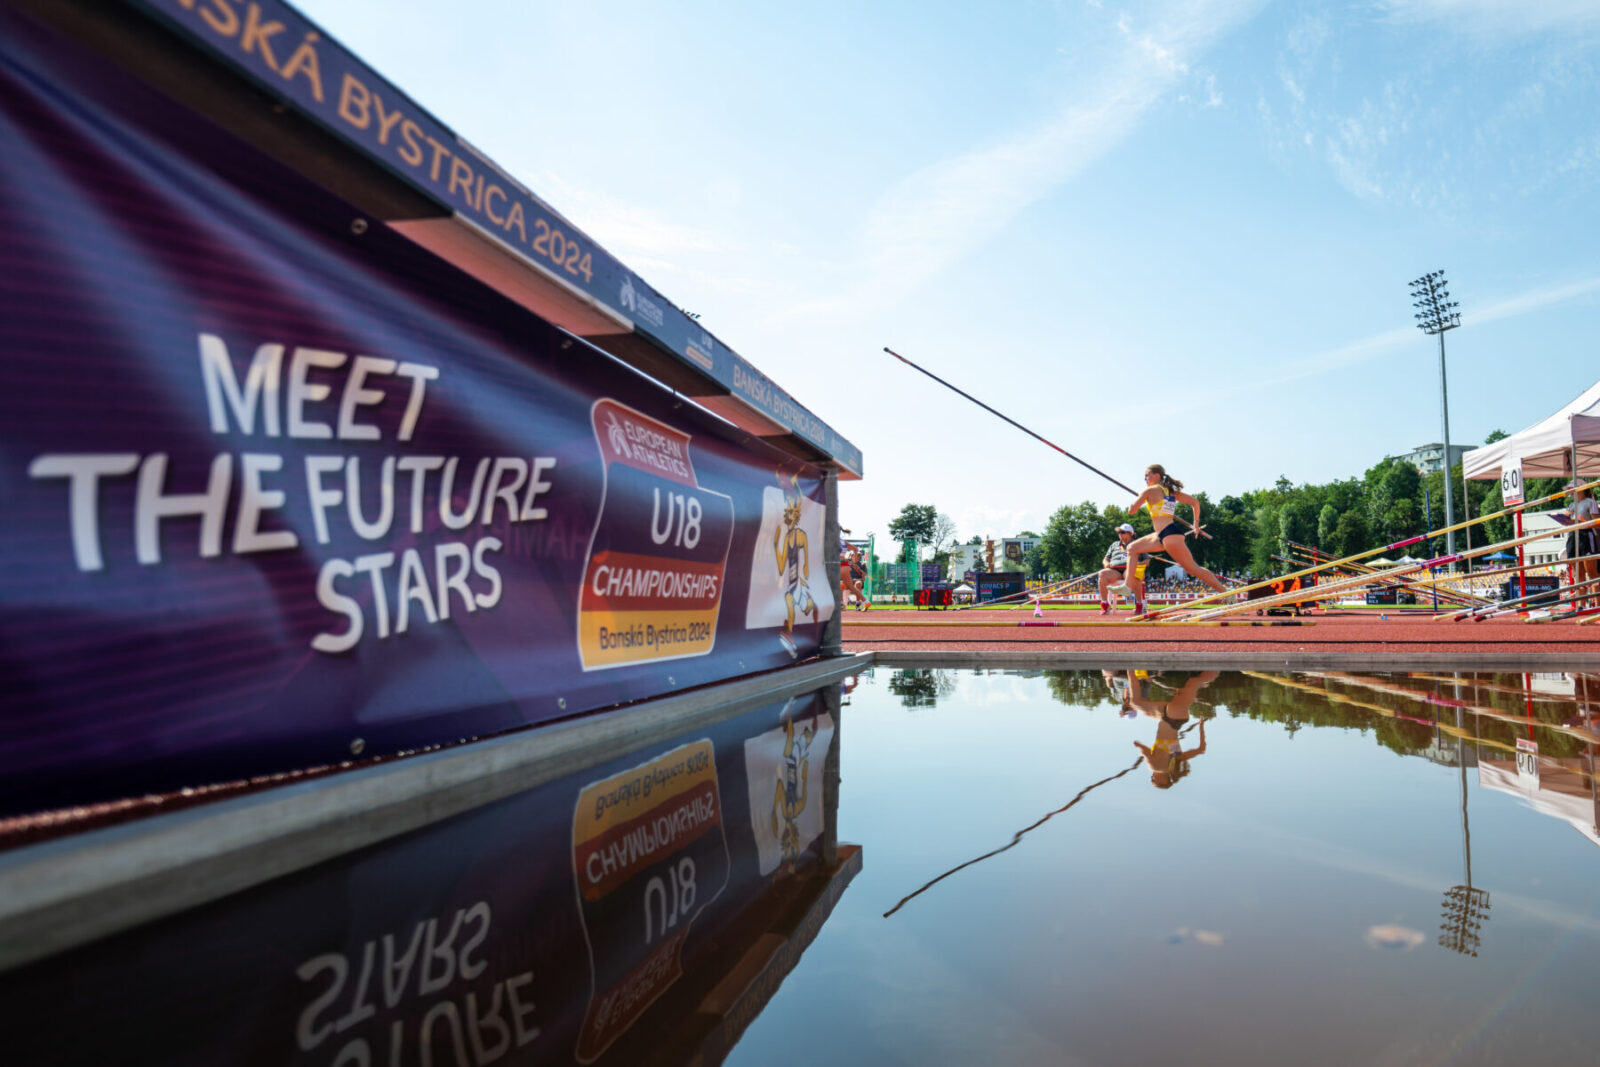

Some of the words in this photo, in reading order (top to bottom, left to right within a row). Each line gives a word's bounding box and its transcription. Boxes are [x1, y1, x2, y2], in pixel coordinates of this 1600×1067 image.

[337, 72, 527, 243] BYSTRICA
[532, 218, 594, 284] 2024
[198, 333, 440, 441] MEET
[733, 363, 773, 411] BANSKÁ
[773, 393, 811, 436] BYSTRICA
[623, 420, 683, 459] EUROPEAN
[632, 443, 689, 478] ATHLETICS
[1502, 469, 1518, 491] 60
[28, 452, 299, 572] THE
[304, 455, 557, 545] FUTURE
[651, 487, 702, 549] U18
[310, 536, 504, 653] STARS
[592, 565, 719, 599] CHAMPIONSHIPS
[600, 623, 644, 650] Banská
[646, 624, 687, 652] Bystrica
[688, 621, 711, 642] 2024
